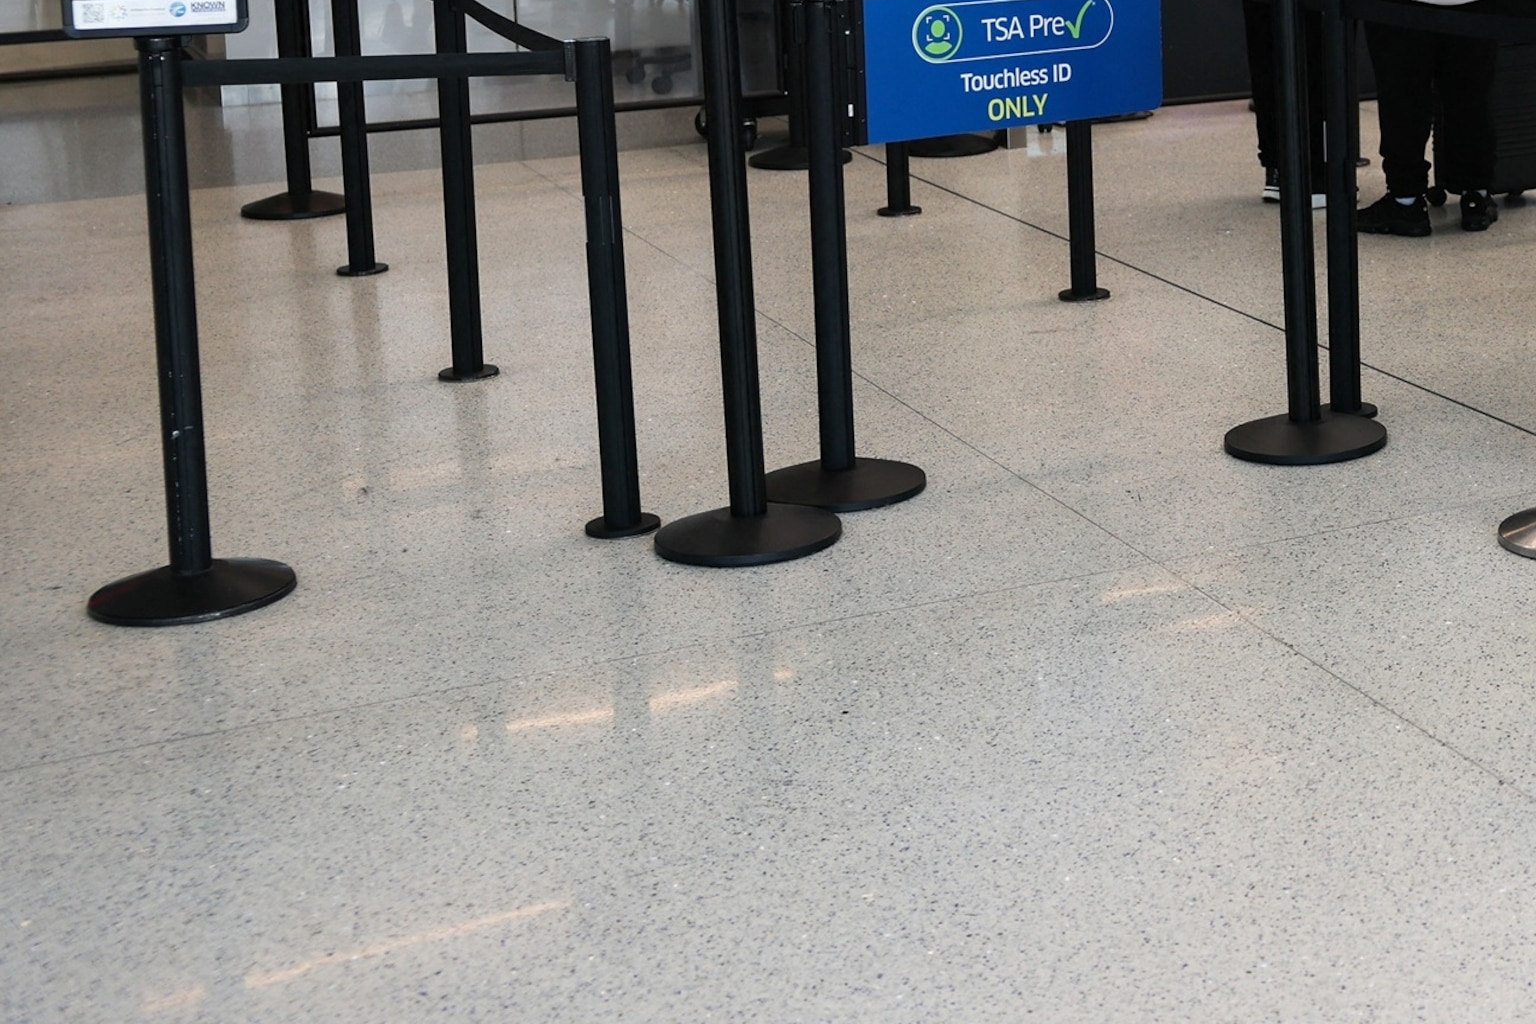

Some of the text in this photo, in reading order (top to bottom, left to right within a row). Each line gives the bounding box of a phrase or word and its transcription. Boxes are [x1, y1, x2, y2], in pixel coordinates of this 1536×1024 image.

[191, 1, 225, 9] KNOWN
[981, 14, 1065, 42] TSA Pre
[960, 63, 1072, 93] Touchless ID
[988, 93, 1048, 122] ONLY
